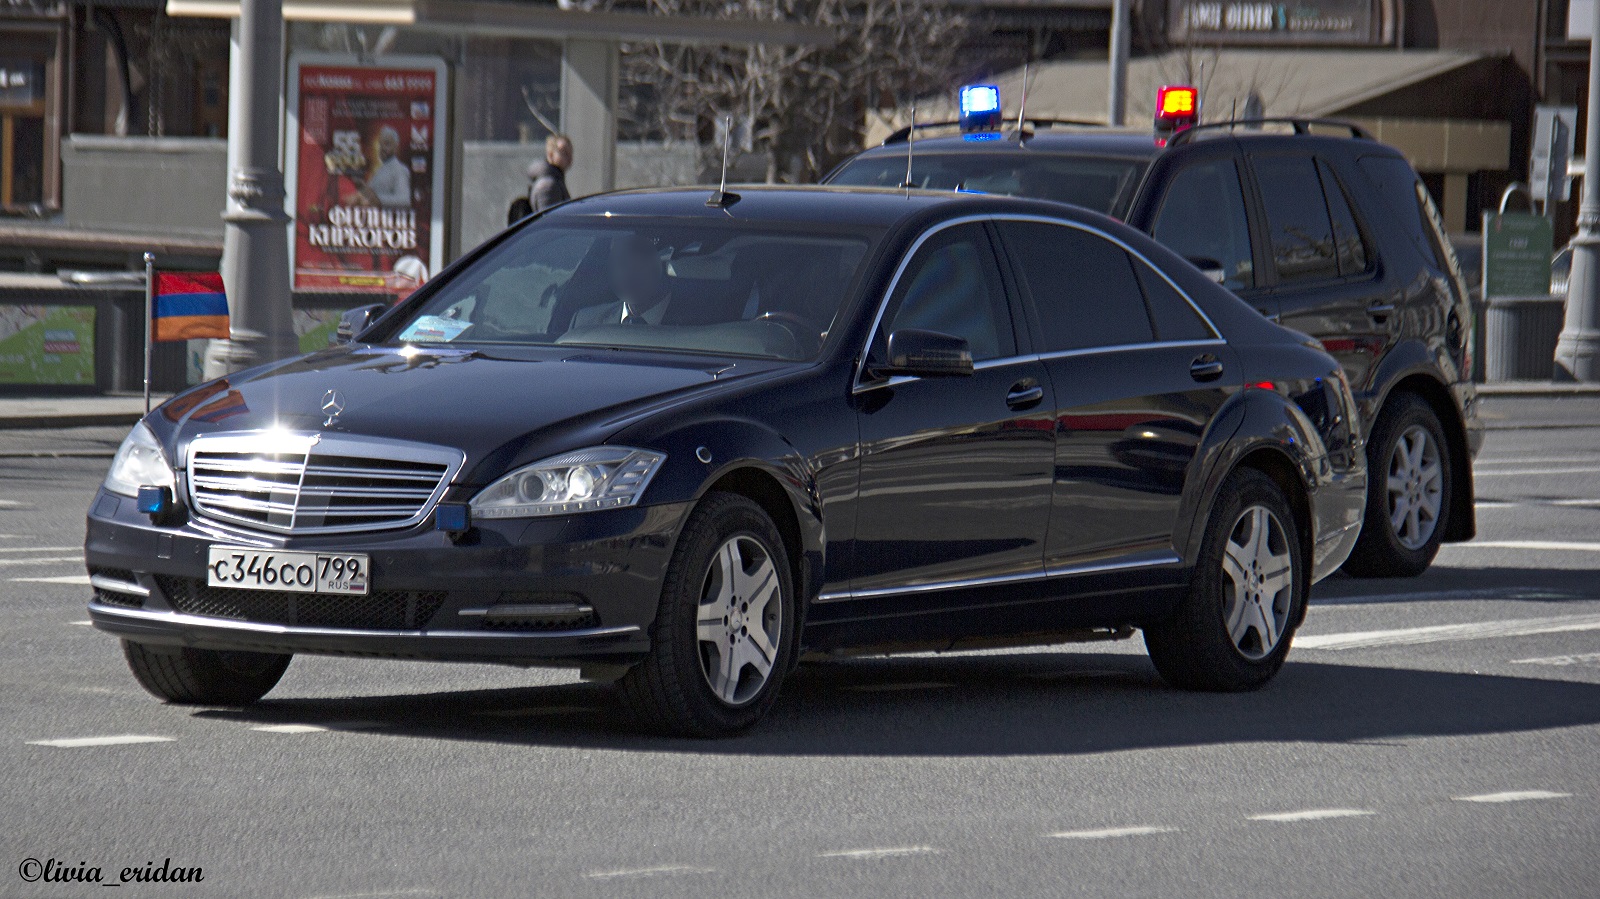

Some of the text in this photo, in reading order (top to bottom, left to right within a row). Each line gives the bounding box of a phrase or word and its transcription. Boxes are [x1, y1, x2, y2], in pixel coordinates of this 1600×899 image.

[328, 205, 416, 230] ФИЛИПП
[308, 224, 417, 249] КИРКОРОВ
[318, 557, 360, 581] 799
[328, 581, 349, 591] RUS
